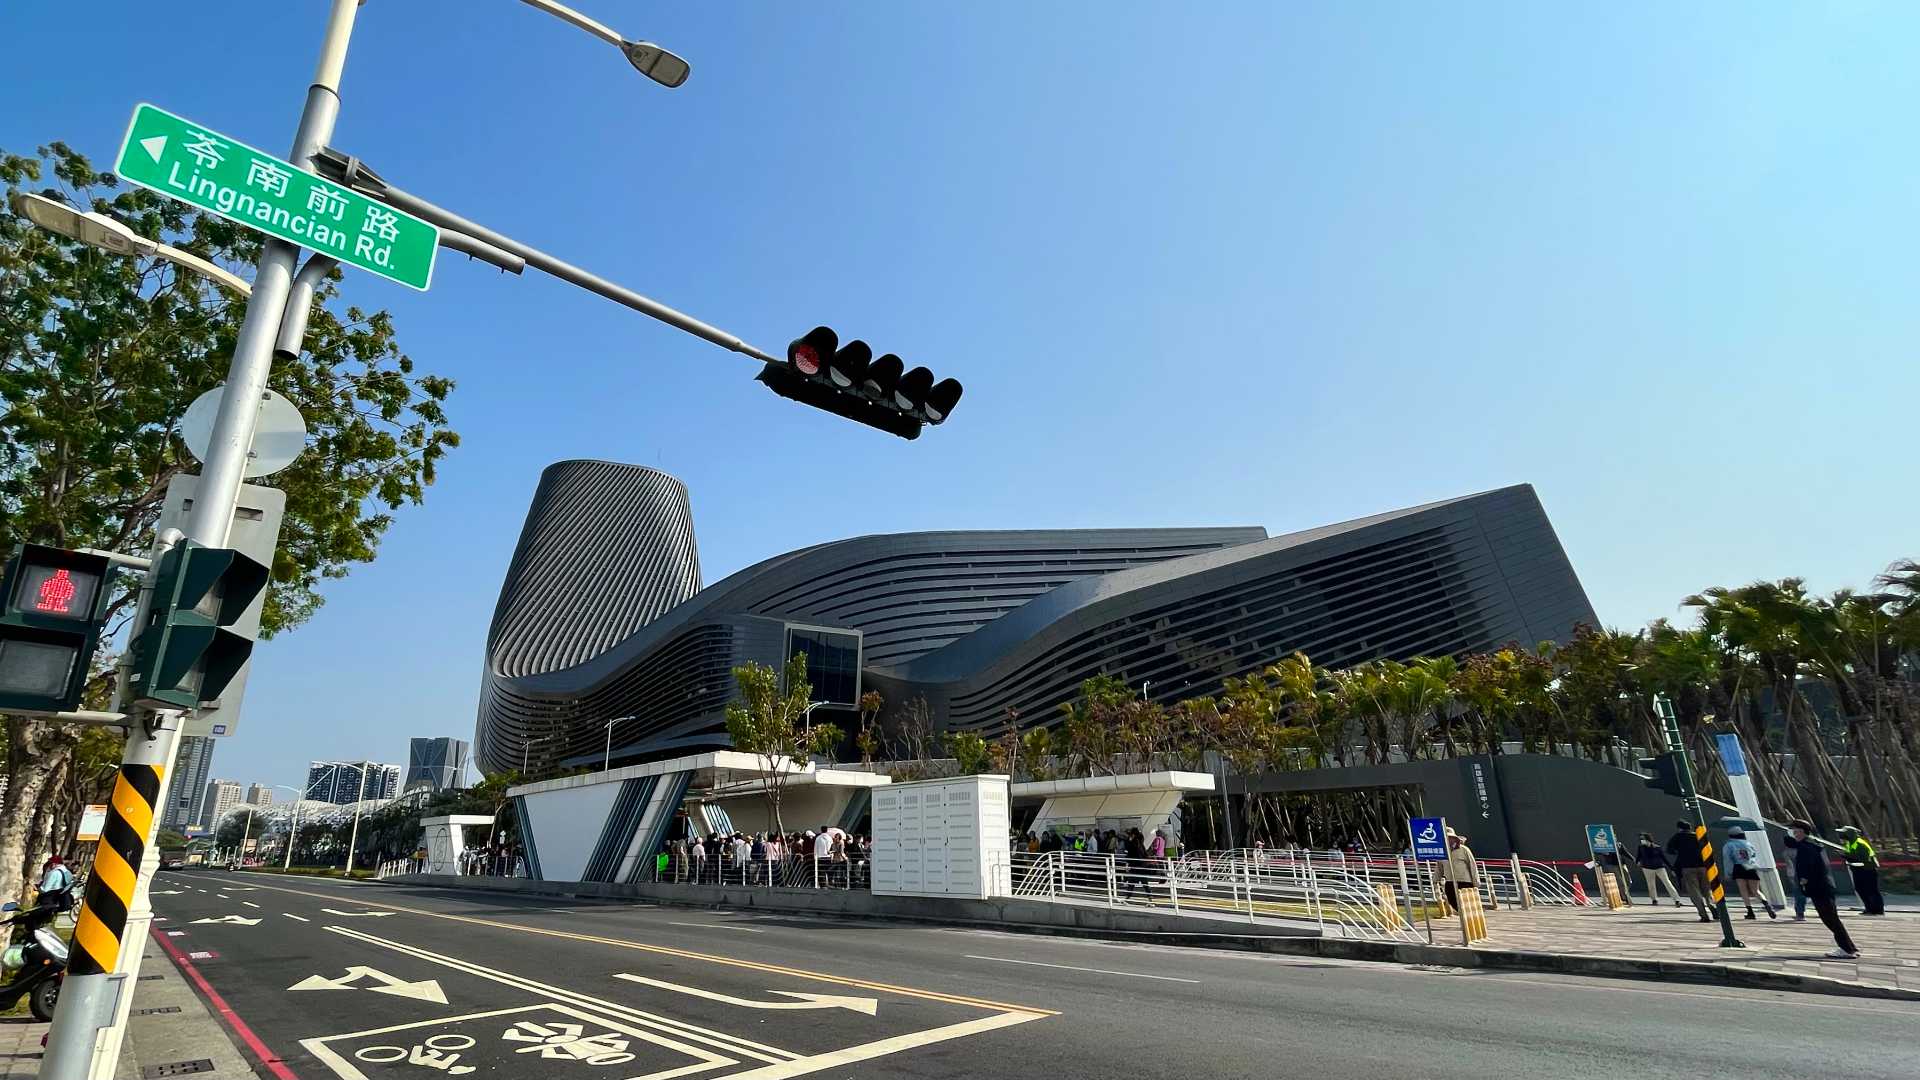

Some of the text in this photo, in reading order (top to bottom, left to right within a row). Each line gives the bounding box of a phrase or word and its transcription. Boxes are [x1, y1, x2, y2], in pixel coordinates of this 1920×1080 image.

[168, 161, 396, 270] Lingnancian Rd.
[183, 129, 400, 244] 苓南前路
